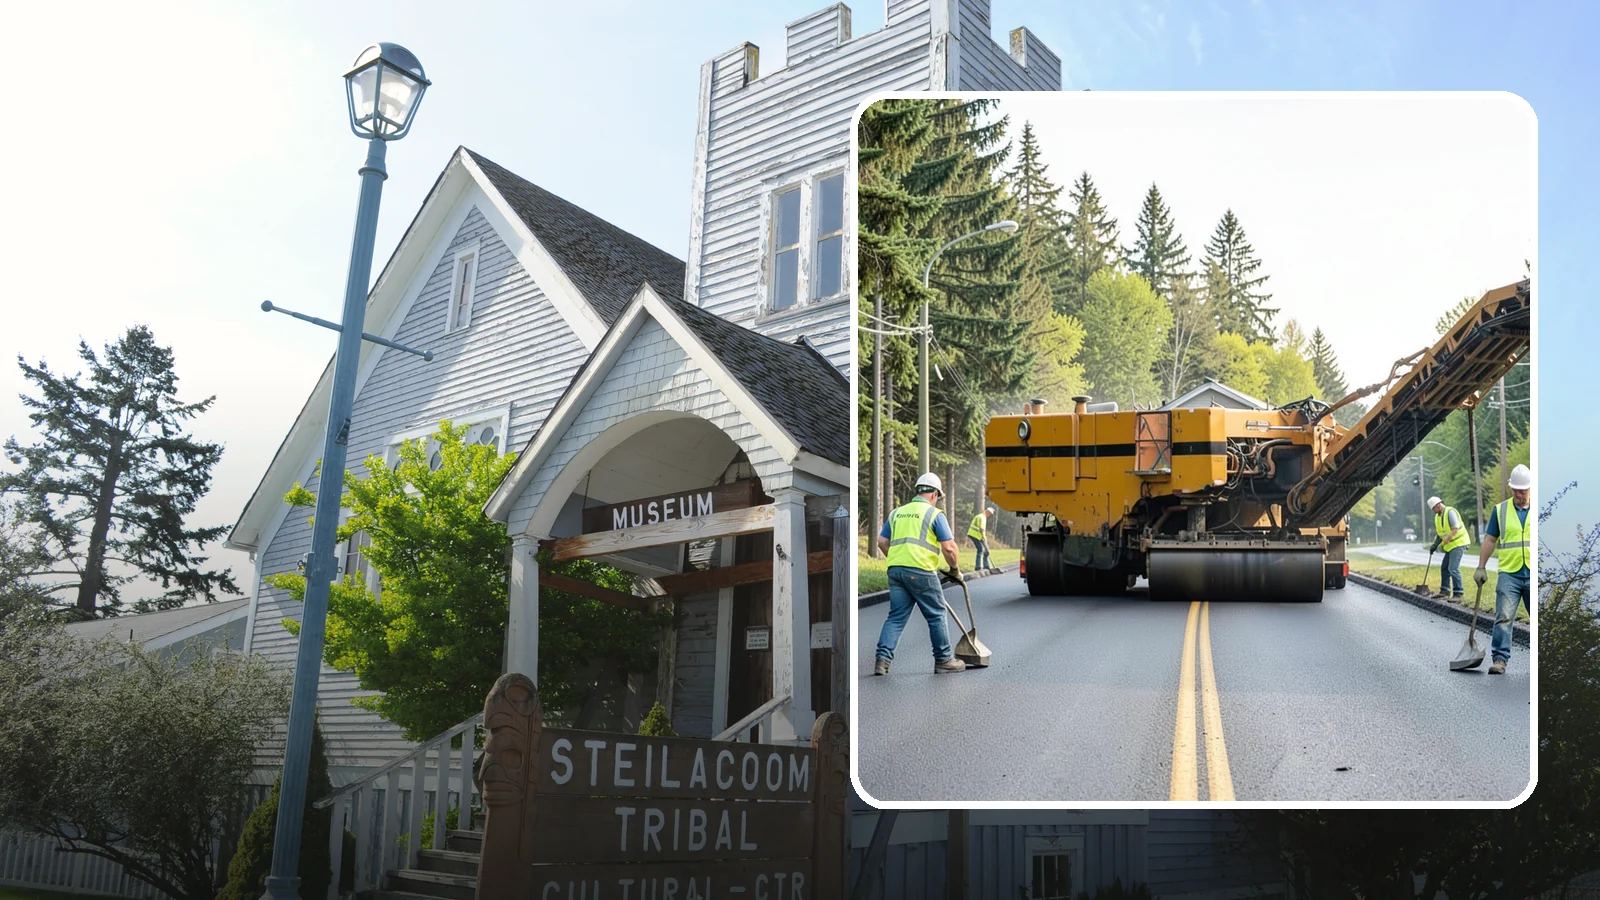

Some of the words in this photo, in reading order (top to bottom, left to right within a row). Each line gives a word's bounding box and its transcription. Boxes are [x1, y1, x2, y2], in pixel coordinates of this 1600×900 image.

[613, 491, 713, 530] MUSEUM
[550, 738, 809, 792] STEILACOOM
[614, 806, 758, 851] TRIBAL
